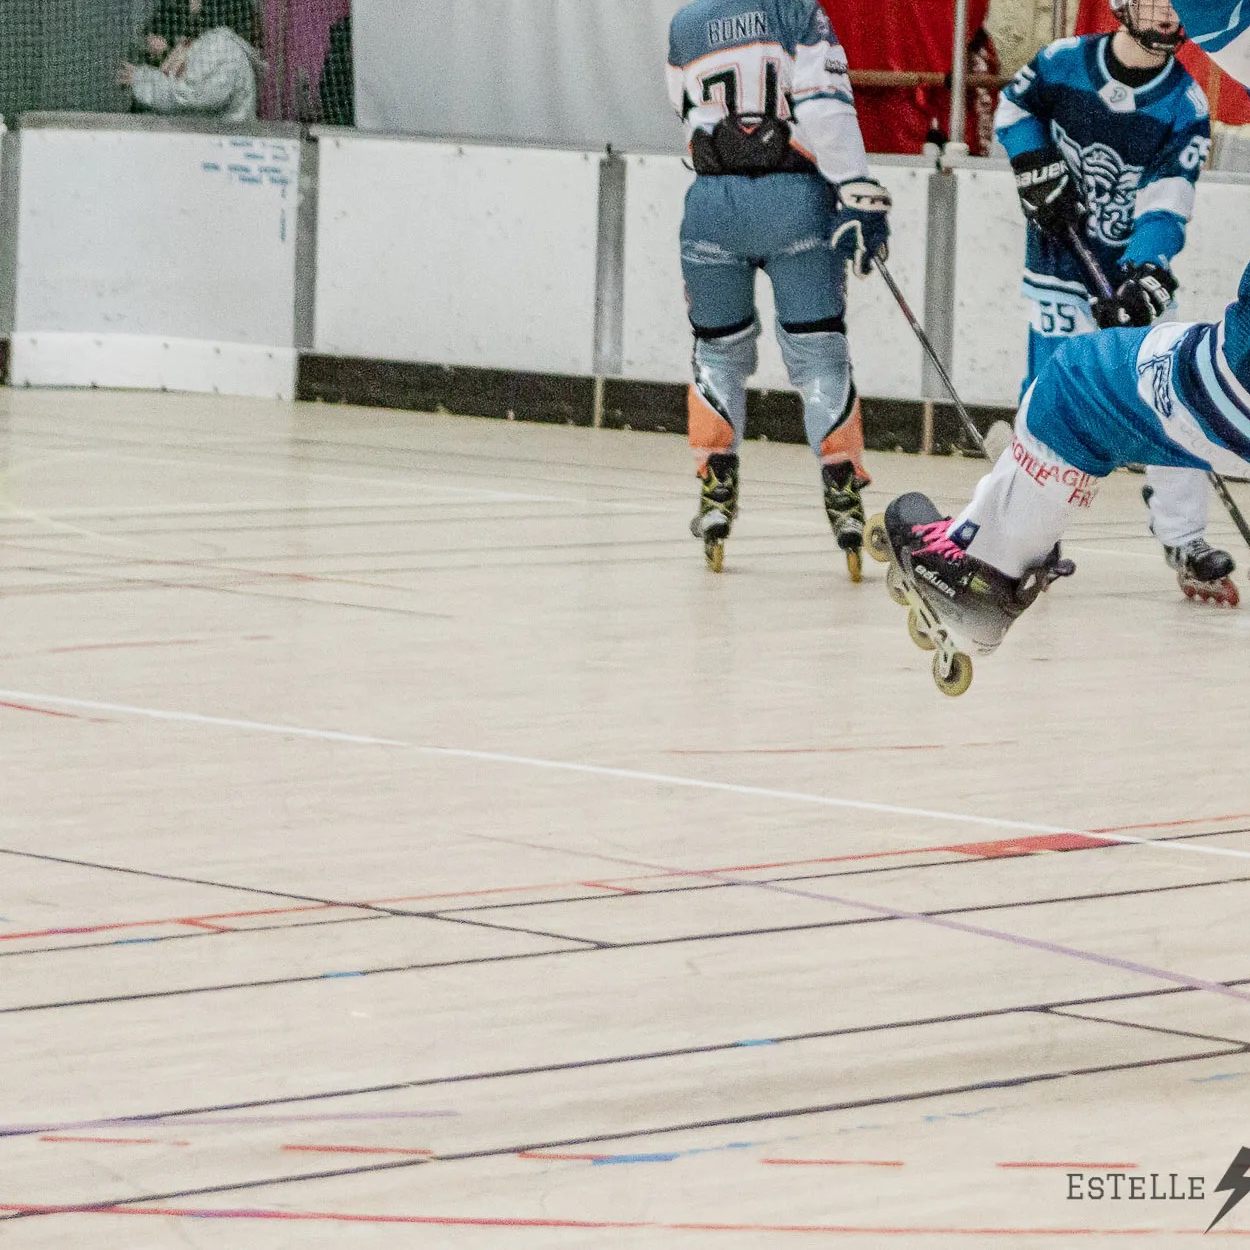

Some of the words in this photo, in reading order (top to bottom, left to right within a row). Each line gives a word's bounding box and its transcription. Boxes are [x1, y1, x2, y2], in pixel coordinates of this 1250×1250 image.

[708, 11, 769, 46] BONIN
[1039, 301, 1077, 334] 65
[914, 564, 957, 598] BAUER
